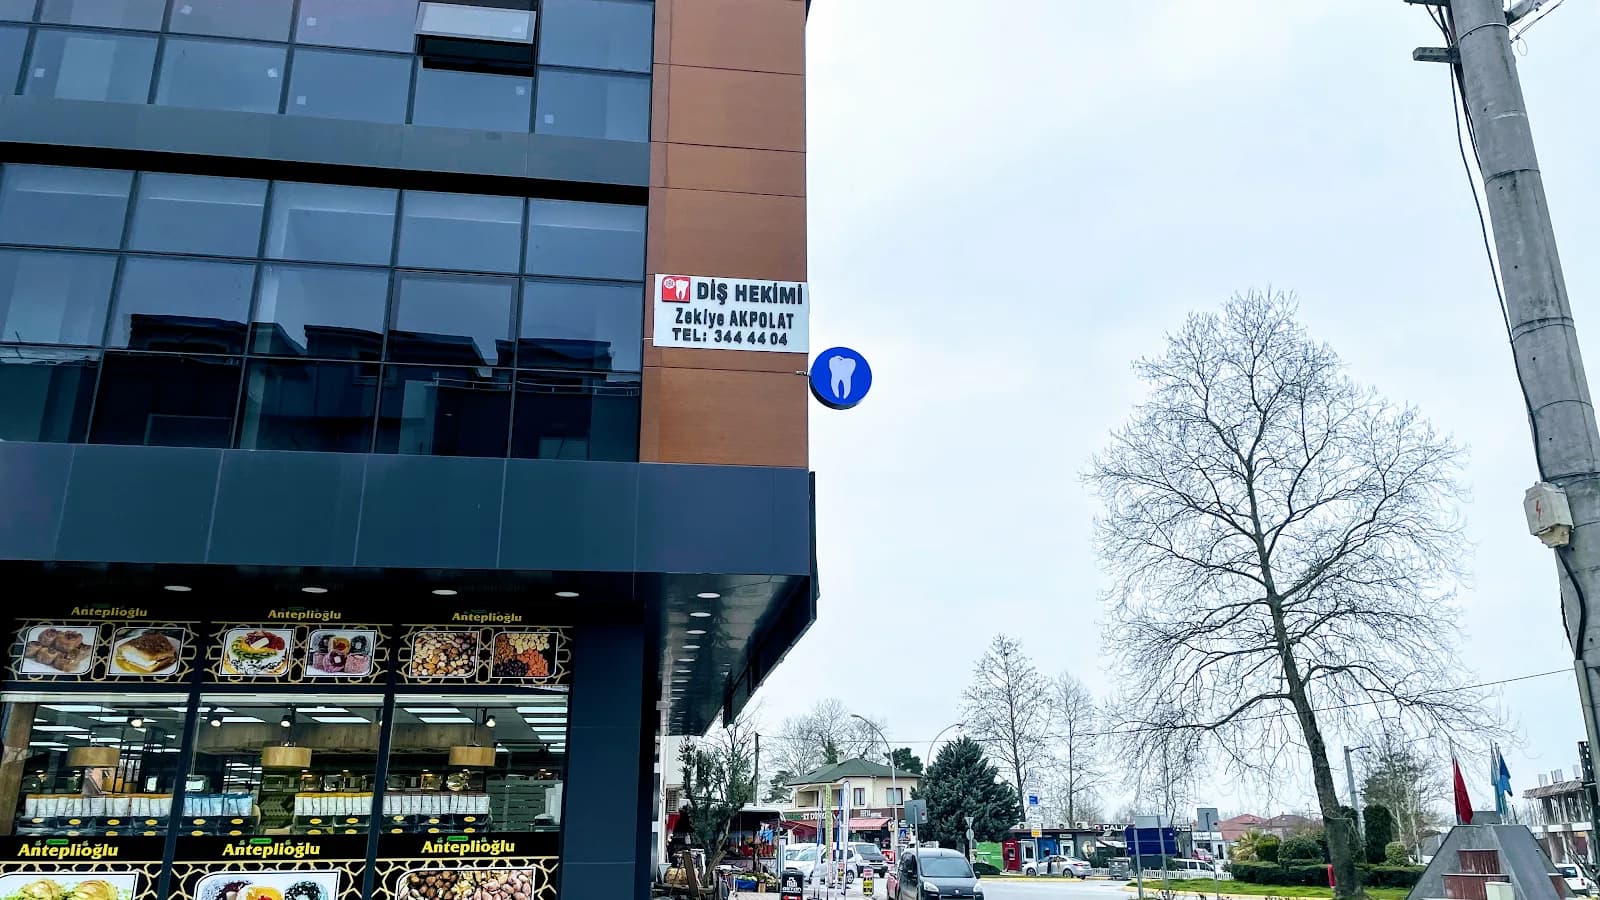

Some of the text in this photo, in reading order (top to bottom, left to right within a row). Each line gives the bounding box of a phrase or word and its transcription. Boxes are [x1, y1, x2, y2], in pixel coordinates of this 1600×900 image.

[697, 279, 803, 305] DİŞ HEKİMİ
[675, 307, 794, 330] Zekiye AKPOLAT
[672, 327, 707, 342] TEL:
[714, 329, 742, 344] 344
[71, 606, 148, 619] Anteplioğlu
[267, 608, 342, 621] Anteplioğlu
[451, 611, 523, 624] Anteplioğlu
[17, 843, 119, 860] Anteplioğlu
[222, 842, 321, 859] Anteplioğlu
[421, 839, 516, 856] Anteplioğlu
